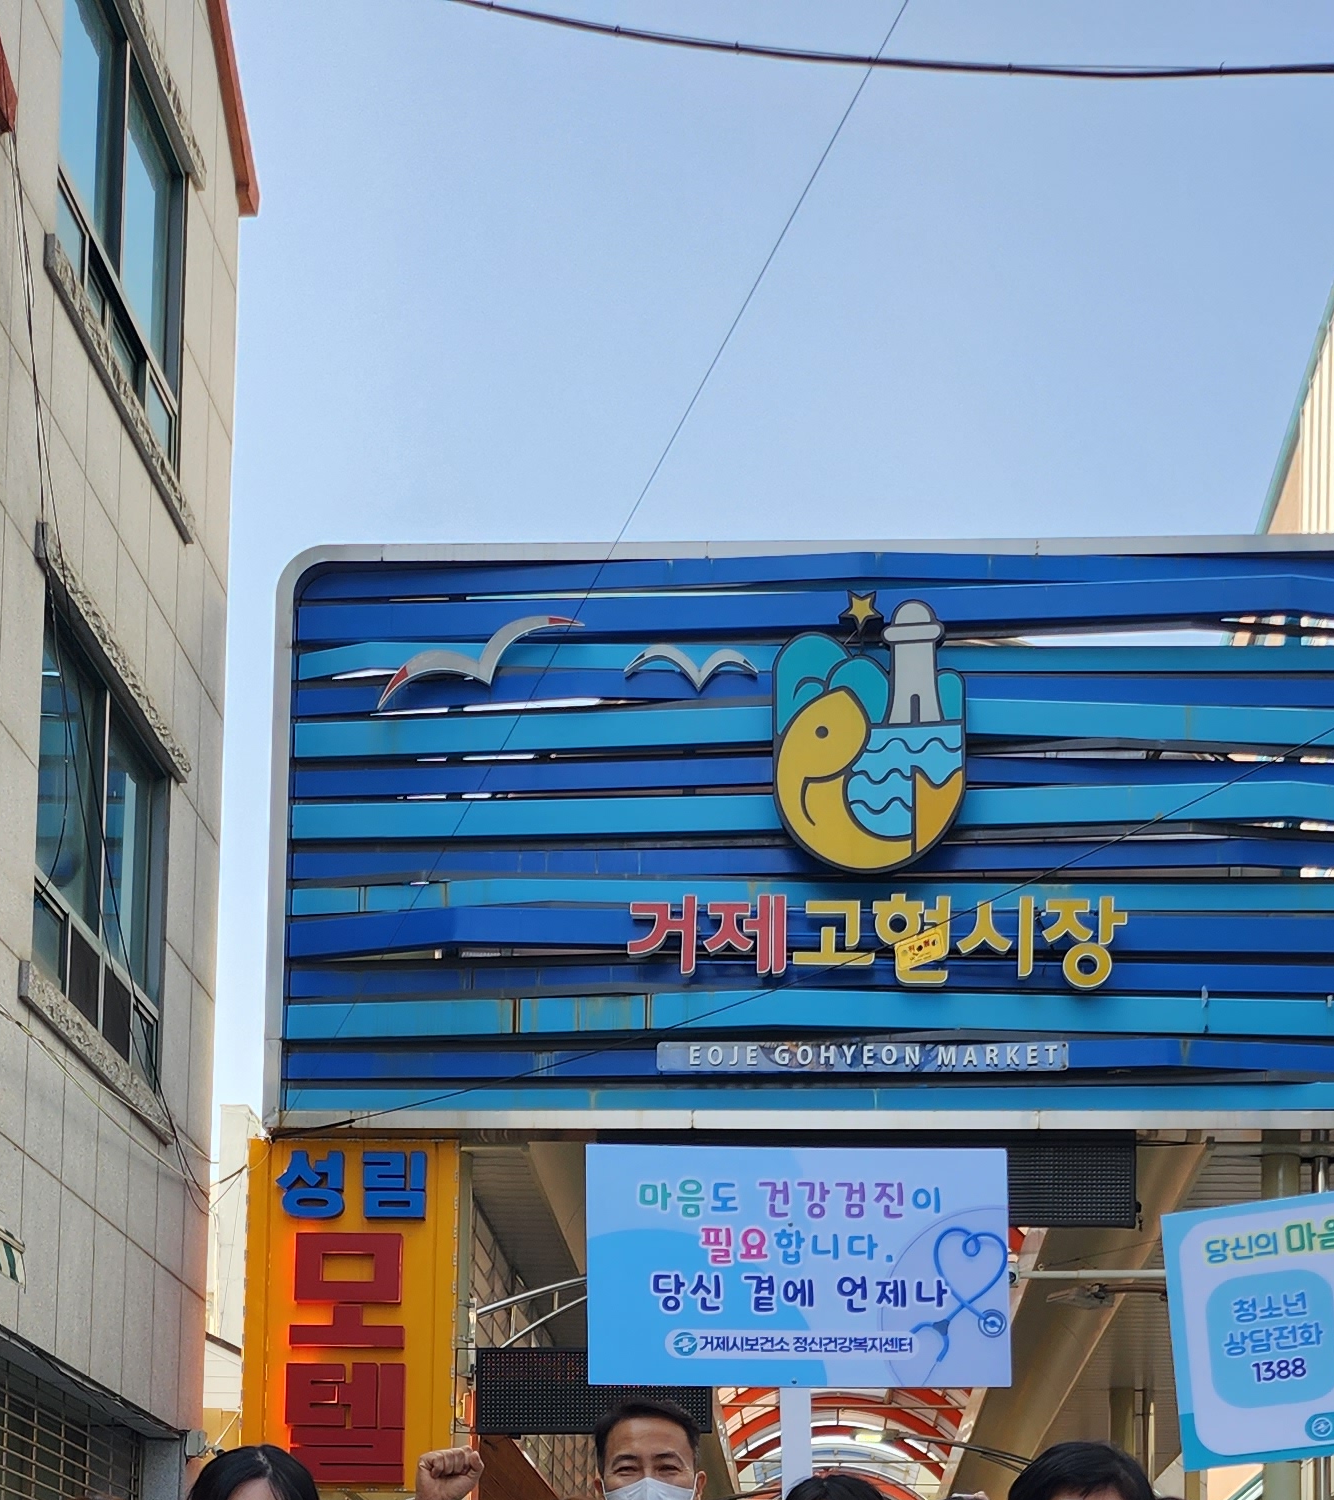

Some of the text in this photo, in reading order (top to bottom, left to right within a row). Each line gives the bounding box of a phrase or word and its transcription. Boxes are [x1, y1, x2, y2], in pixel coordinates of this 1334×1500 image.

[688, 1044, 1059, 1069] EOJE GOHYEON MARKET
[275, 1150, 428, 1222] 성림
[638, 1178, 942, 1219] 마음도 건강검진이
[701, 1226, 894, 1265] 필요합니다.
[1204, 1230, 1279, 1265] 당신의
[651, 1273, 950, 1313] 당신 곁에 언제나
[1232, 1291, 1309, 1323] 청소년
[699, 1335, 913, 1355] 거제시보건소 정신건강복지센터
[1222, 1322, 1324, 1358] 상담전화
[285, 1232, 407, 1485] 모텔
[1250, 1357, 1308, 1384] 1388
